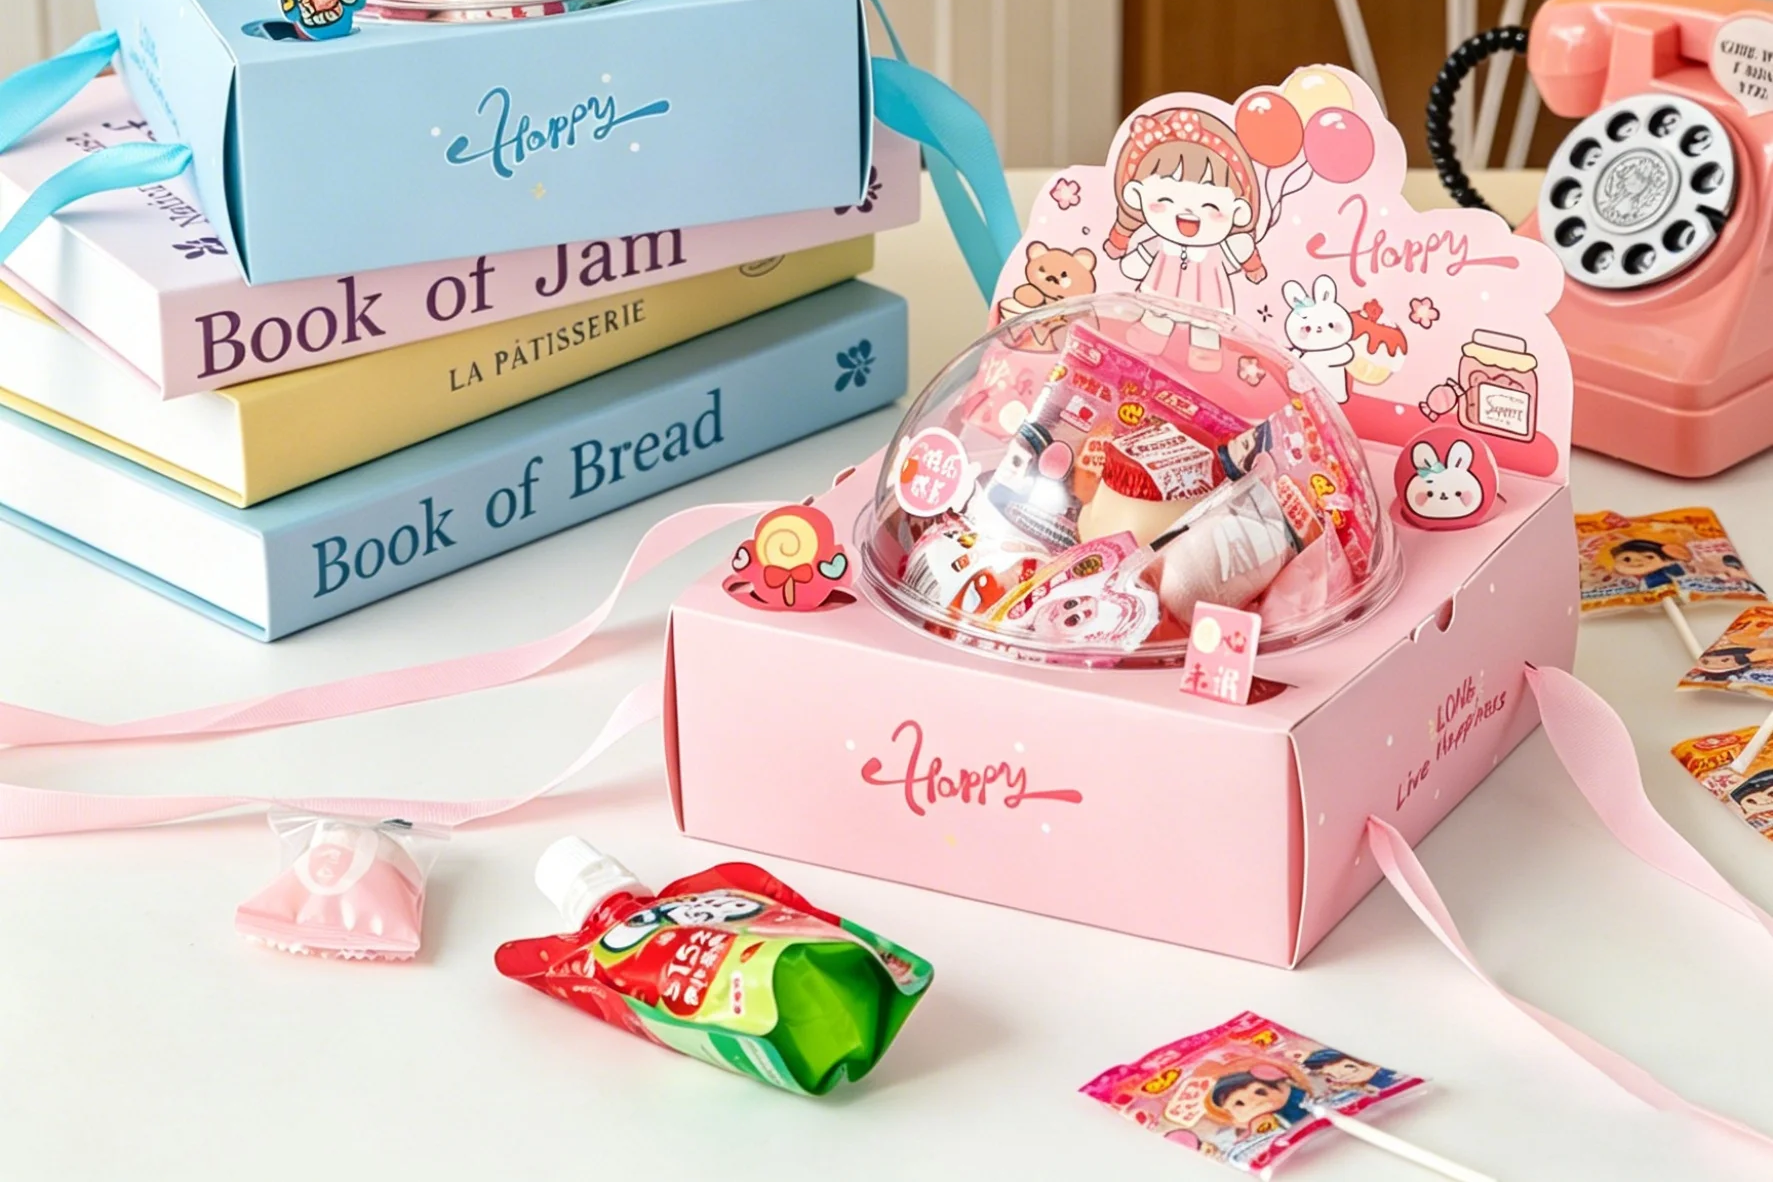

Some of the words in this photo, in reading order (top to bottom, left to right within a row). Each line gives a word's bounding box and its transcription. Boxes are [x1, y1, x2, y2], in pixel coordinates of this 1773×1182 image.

[445, 87, 671, 179] Happy
[1306, 194, 1520, 287] Happy
[195, 275, 387, 380] Book
[426, 255, 496, 322] of
[535, 228, 688, 298] Jam
[449, 359, 484, 393] LA
[312, 496, 458, 600] Book
[485, 455, 544, 530] of
[569, 387, 725, 500] Bread
[860, 719, 1083, 817] Happy
[1396, 759, 1431, 812] Live
